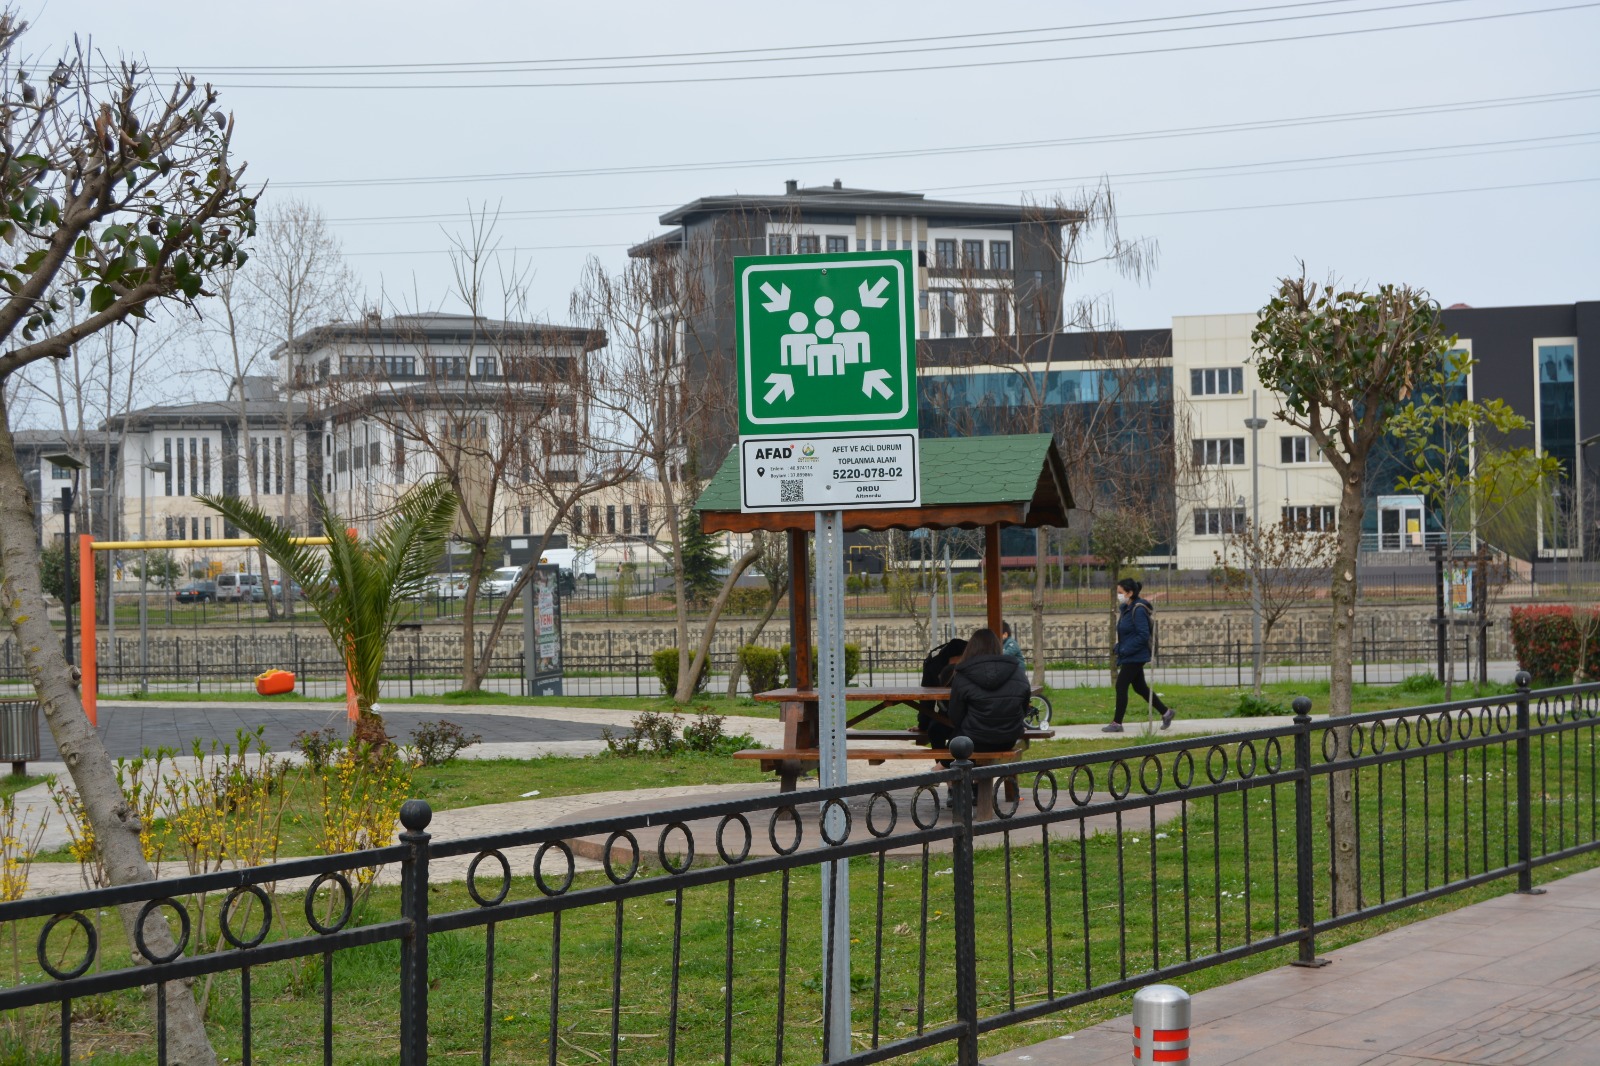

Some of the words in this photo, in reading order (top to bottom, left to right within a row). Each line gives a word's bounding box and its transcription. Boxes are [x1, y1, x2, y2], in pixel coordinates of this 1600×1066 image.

[832, 445, 848, 453] AFET
[849, 445, 859, 453] VE
[876, 444, 902, 452] DURUM
[755, 447, 792, 460] AFAD
[838, 457, 876, 465] TOPLANMA
[876, 456, 897, 464] ALANI
[833, 467, 903, 480] 5220-078-02
[856, 485, 880, 493] ORDU
